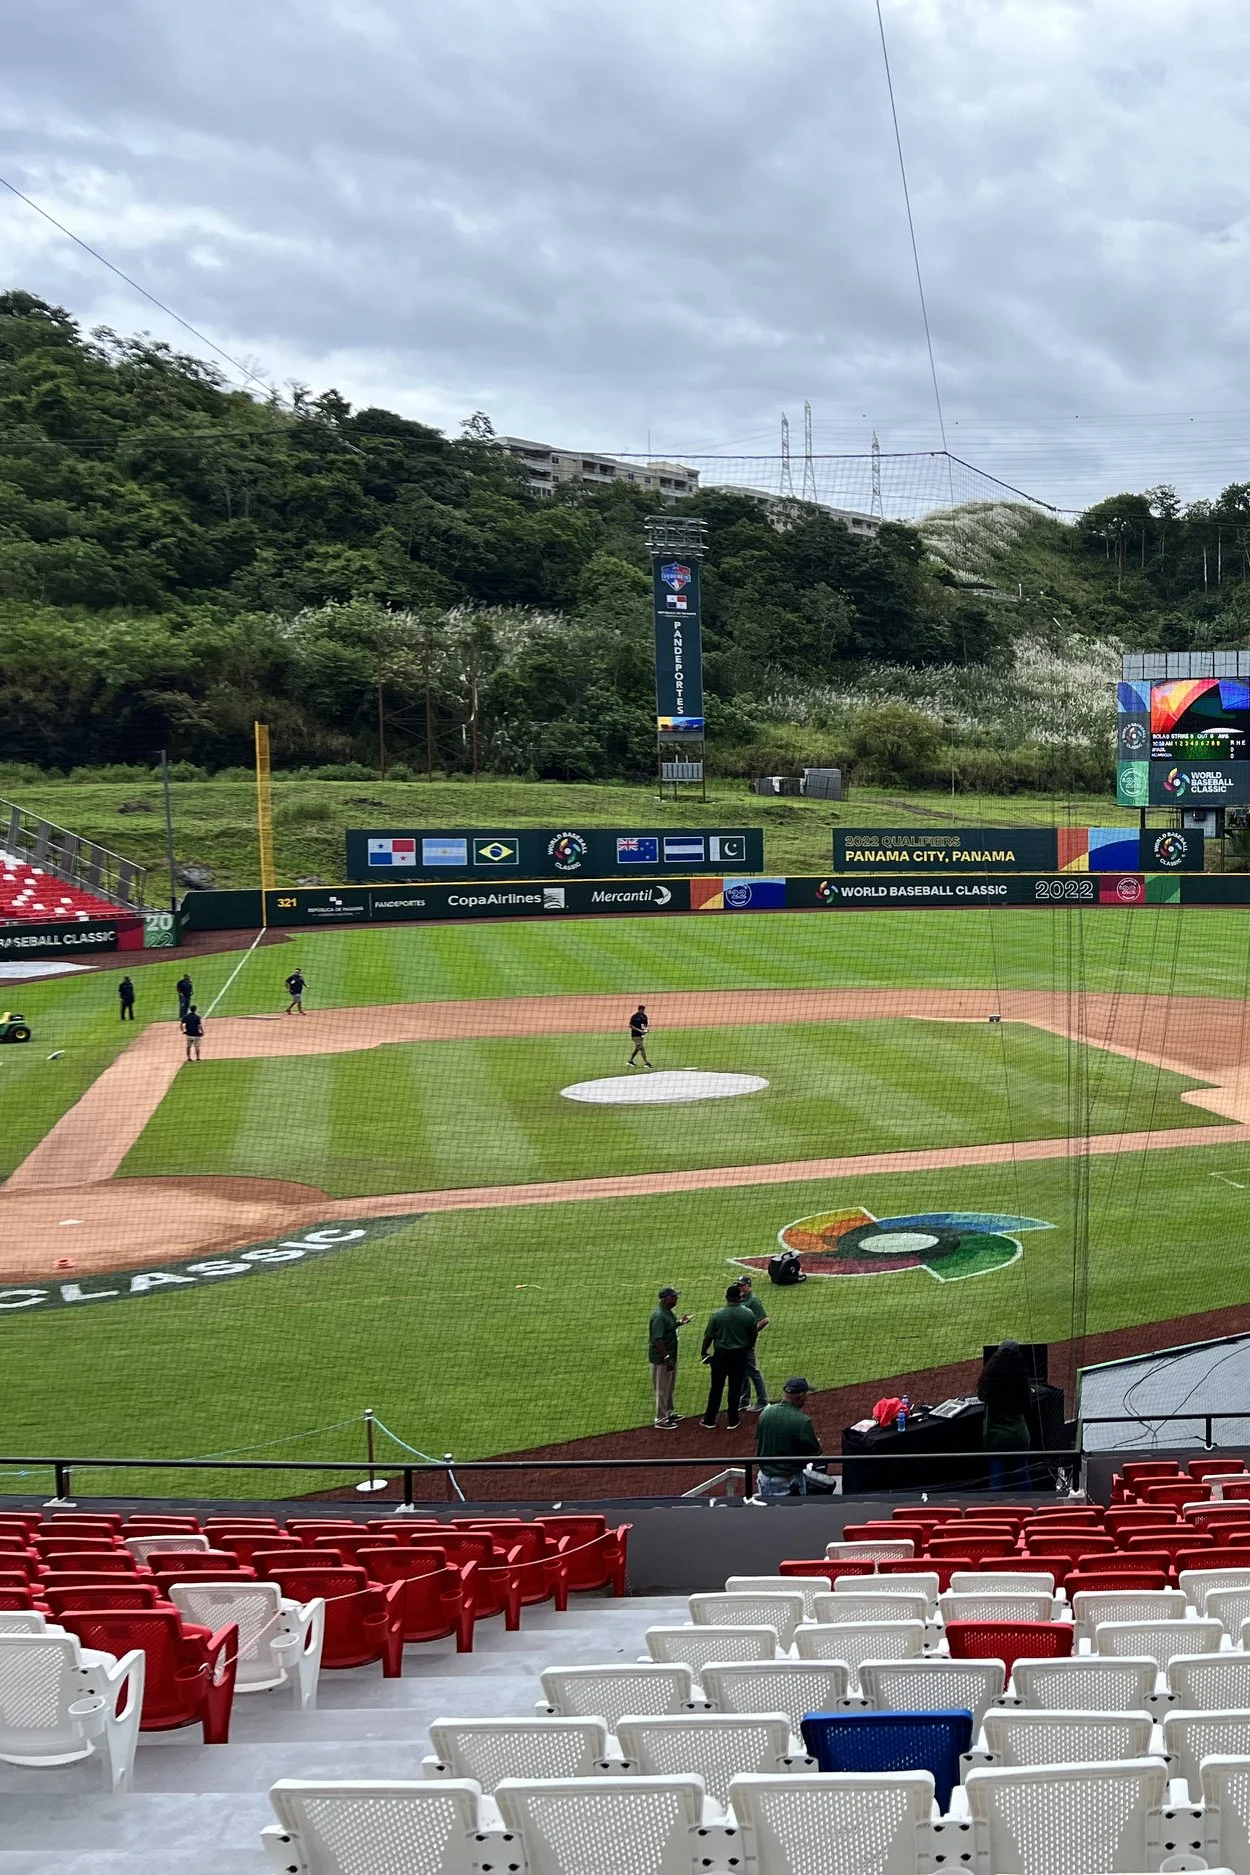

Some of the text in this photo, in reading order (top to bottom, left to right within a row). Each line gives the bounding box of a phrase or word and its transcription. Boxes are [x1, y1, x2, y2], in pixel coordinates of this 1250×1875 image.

[673, 621, 684, 715] PANDEPORTES
[1191, 785, 1227, 793] CLASSIC
[547, 834, 562, 855] WORLD
[562, 832, 588, 855] BASEBALL
[845, 835, 961, 847] 2022 QUALIFIERS
[1154, 833, 1167, 852] WORLD
[1167, 832, 1188, 852] BASEBALL
[845, 850, 1015, 864] PANAMA CITY, PANAMA
[591, 889, 653, 903] Mercantil
[841, 885, 1007, 897] WORLD BASEBALL CLASSIC
[1035, 880, 1093, 899] 2022
[277, 898, 297, 908] 321
[374, 900, 426, 908] PANDEPORTES
[448, 893, 542, 907] CopaAirlines
[146, 915, 174, 931] 20
[63, 931, 116, 944] CLASSIC
[0, 1228, 367, 1309] CLASSIC
